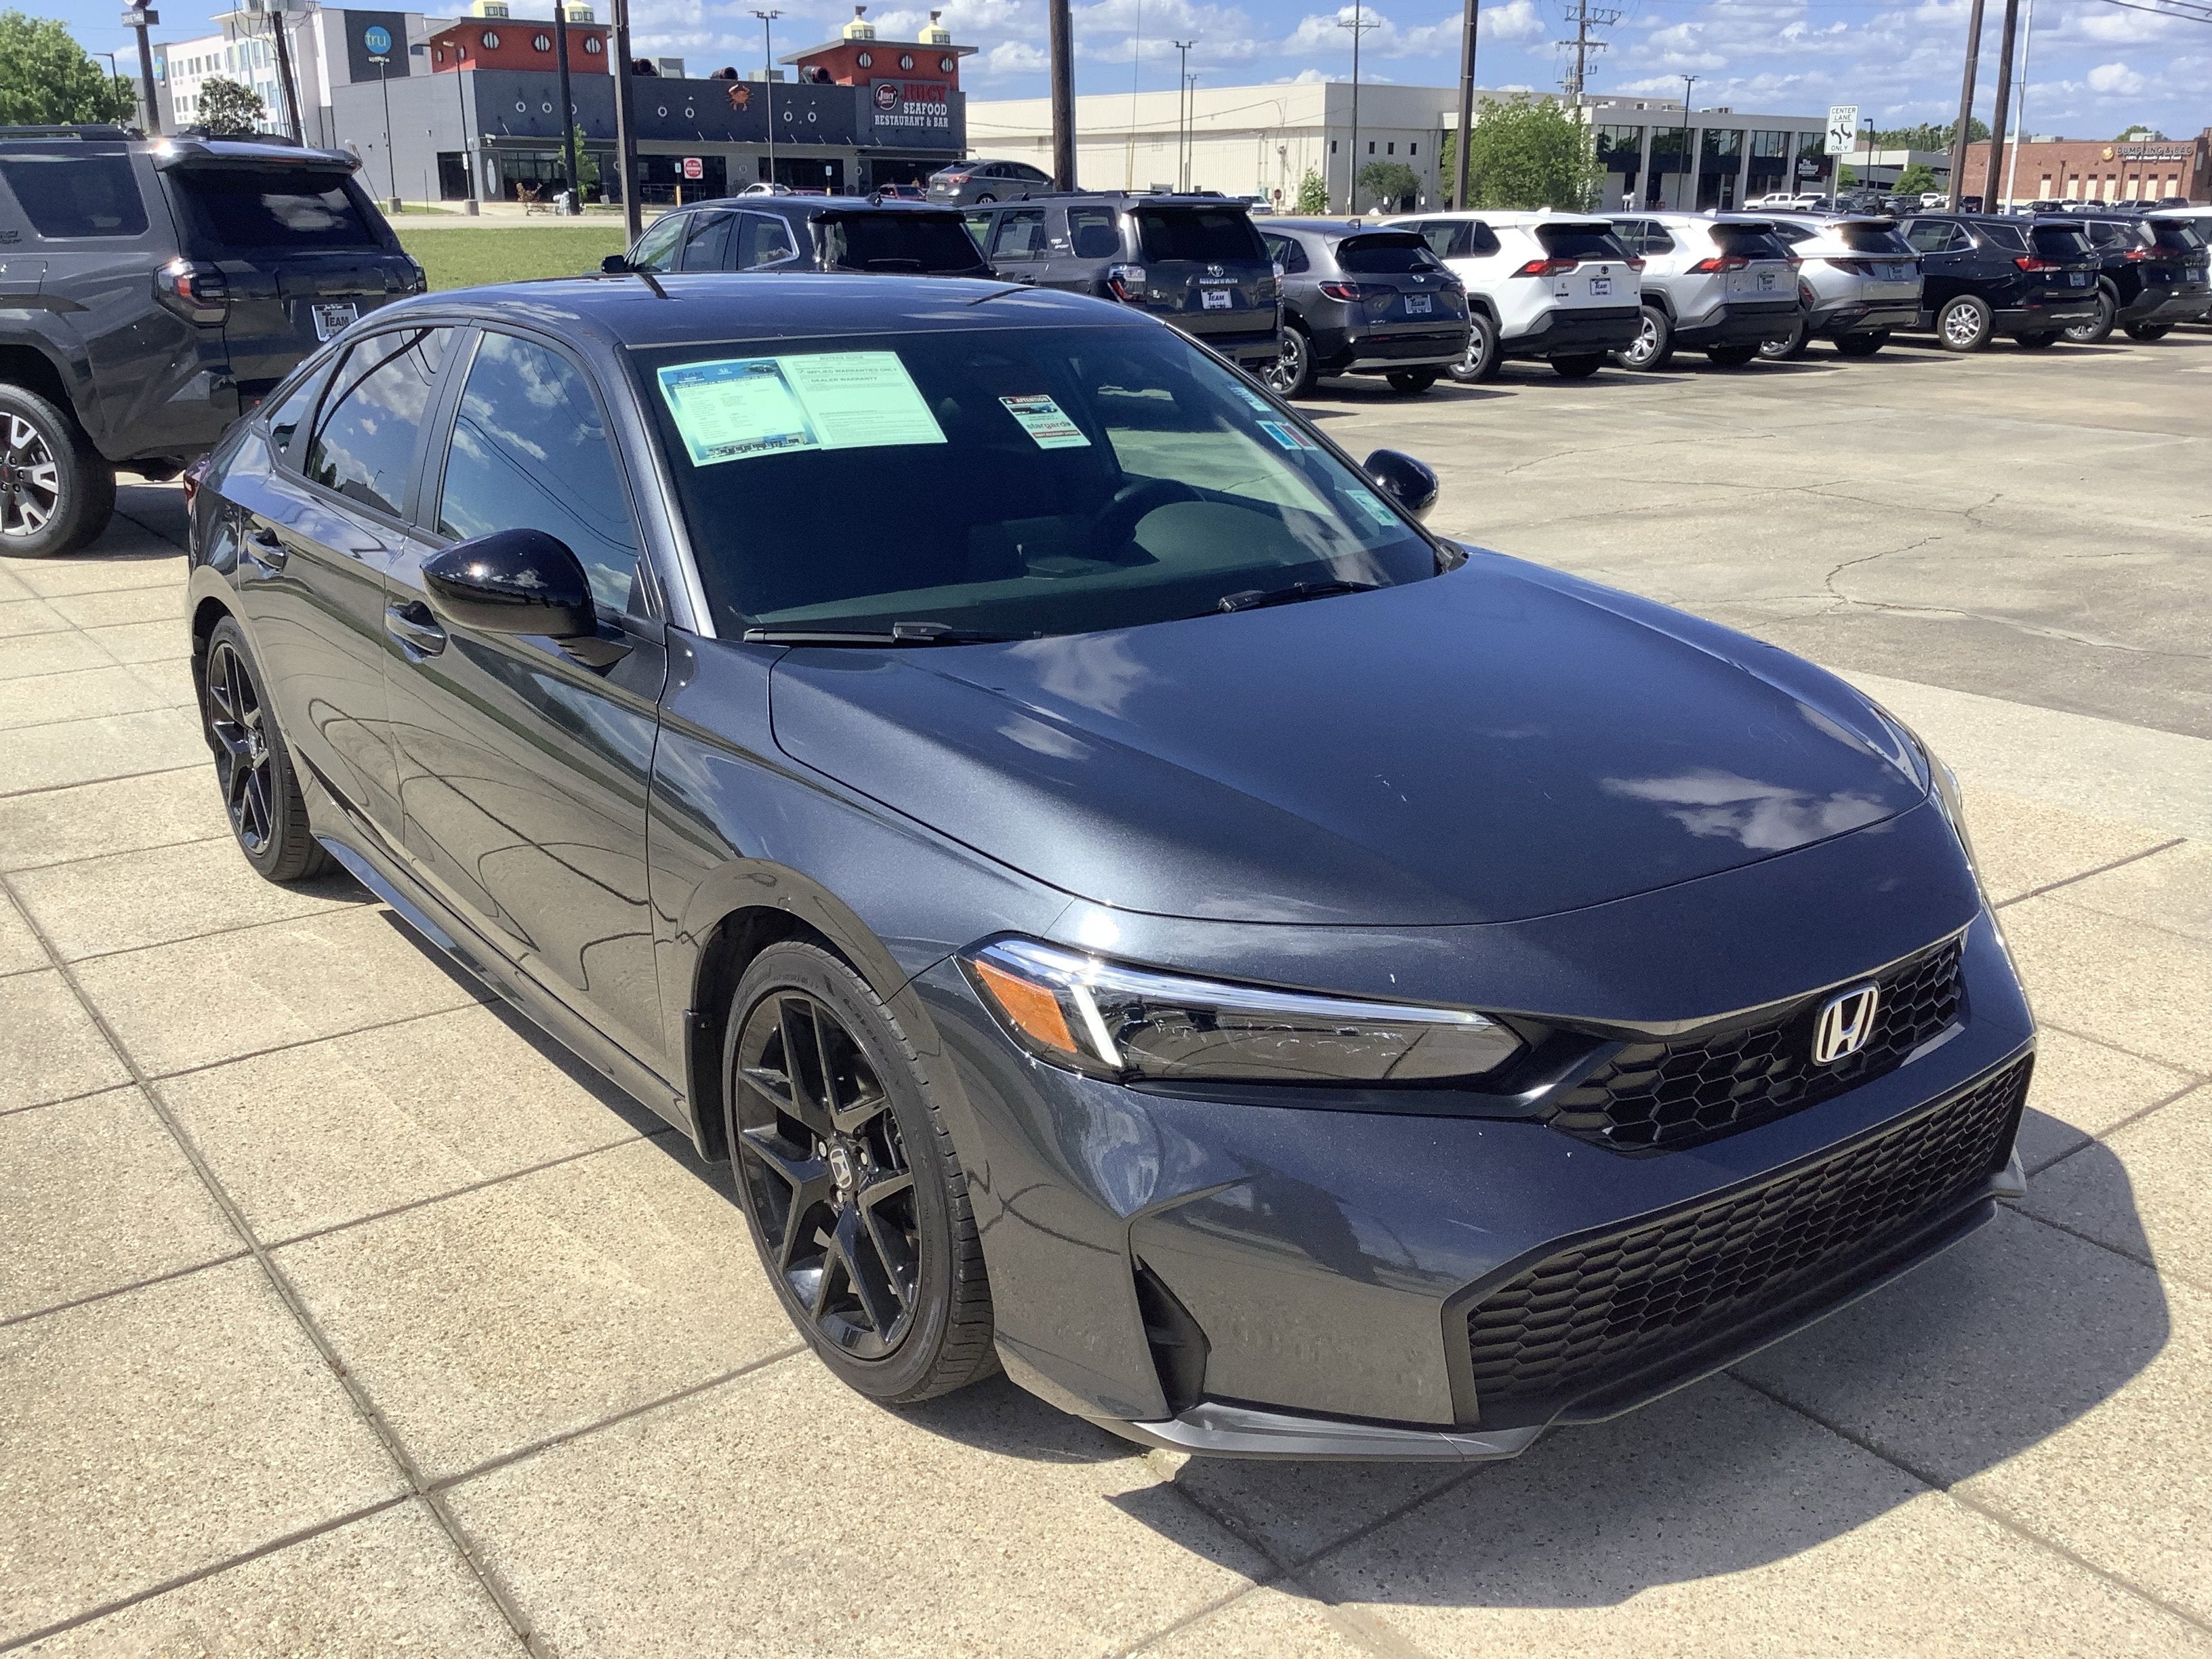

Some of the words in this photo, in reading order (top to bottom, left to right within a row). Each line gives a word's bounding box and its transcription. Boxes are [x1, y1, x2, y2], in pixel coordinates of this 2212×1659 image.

[366, 32, 387, 47] tru
[901, 83, 946, 102] JUICY
[903, 102, 947, 115] SEAFOOD
[875, 115, 924, 127] RESTAURANT
[926, 117, 931, 127] &
[934, 117, 948, 127] BAR
[2117, 146, 2164, 155] DUMPING
[1208, 293, 1225, 302] TEAM
[322, 312, 349, 327] TEAM
